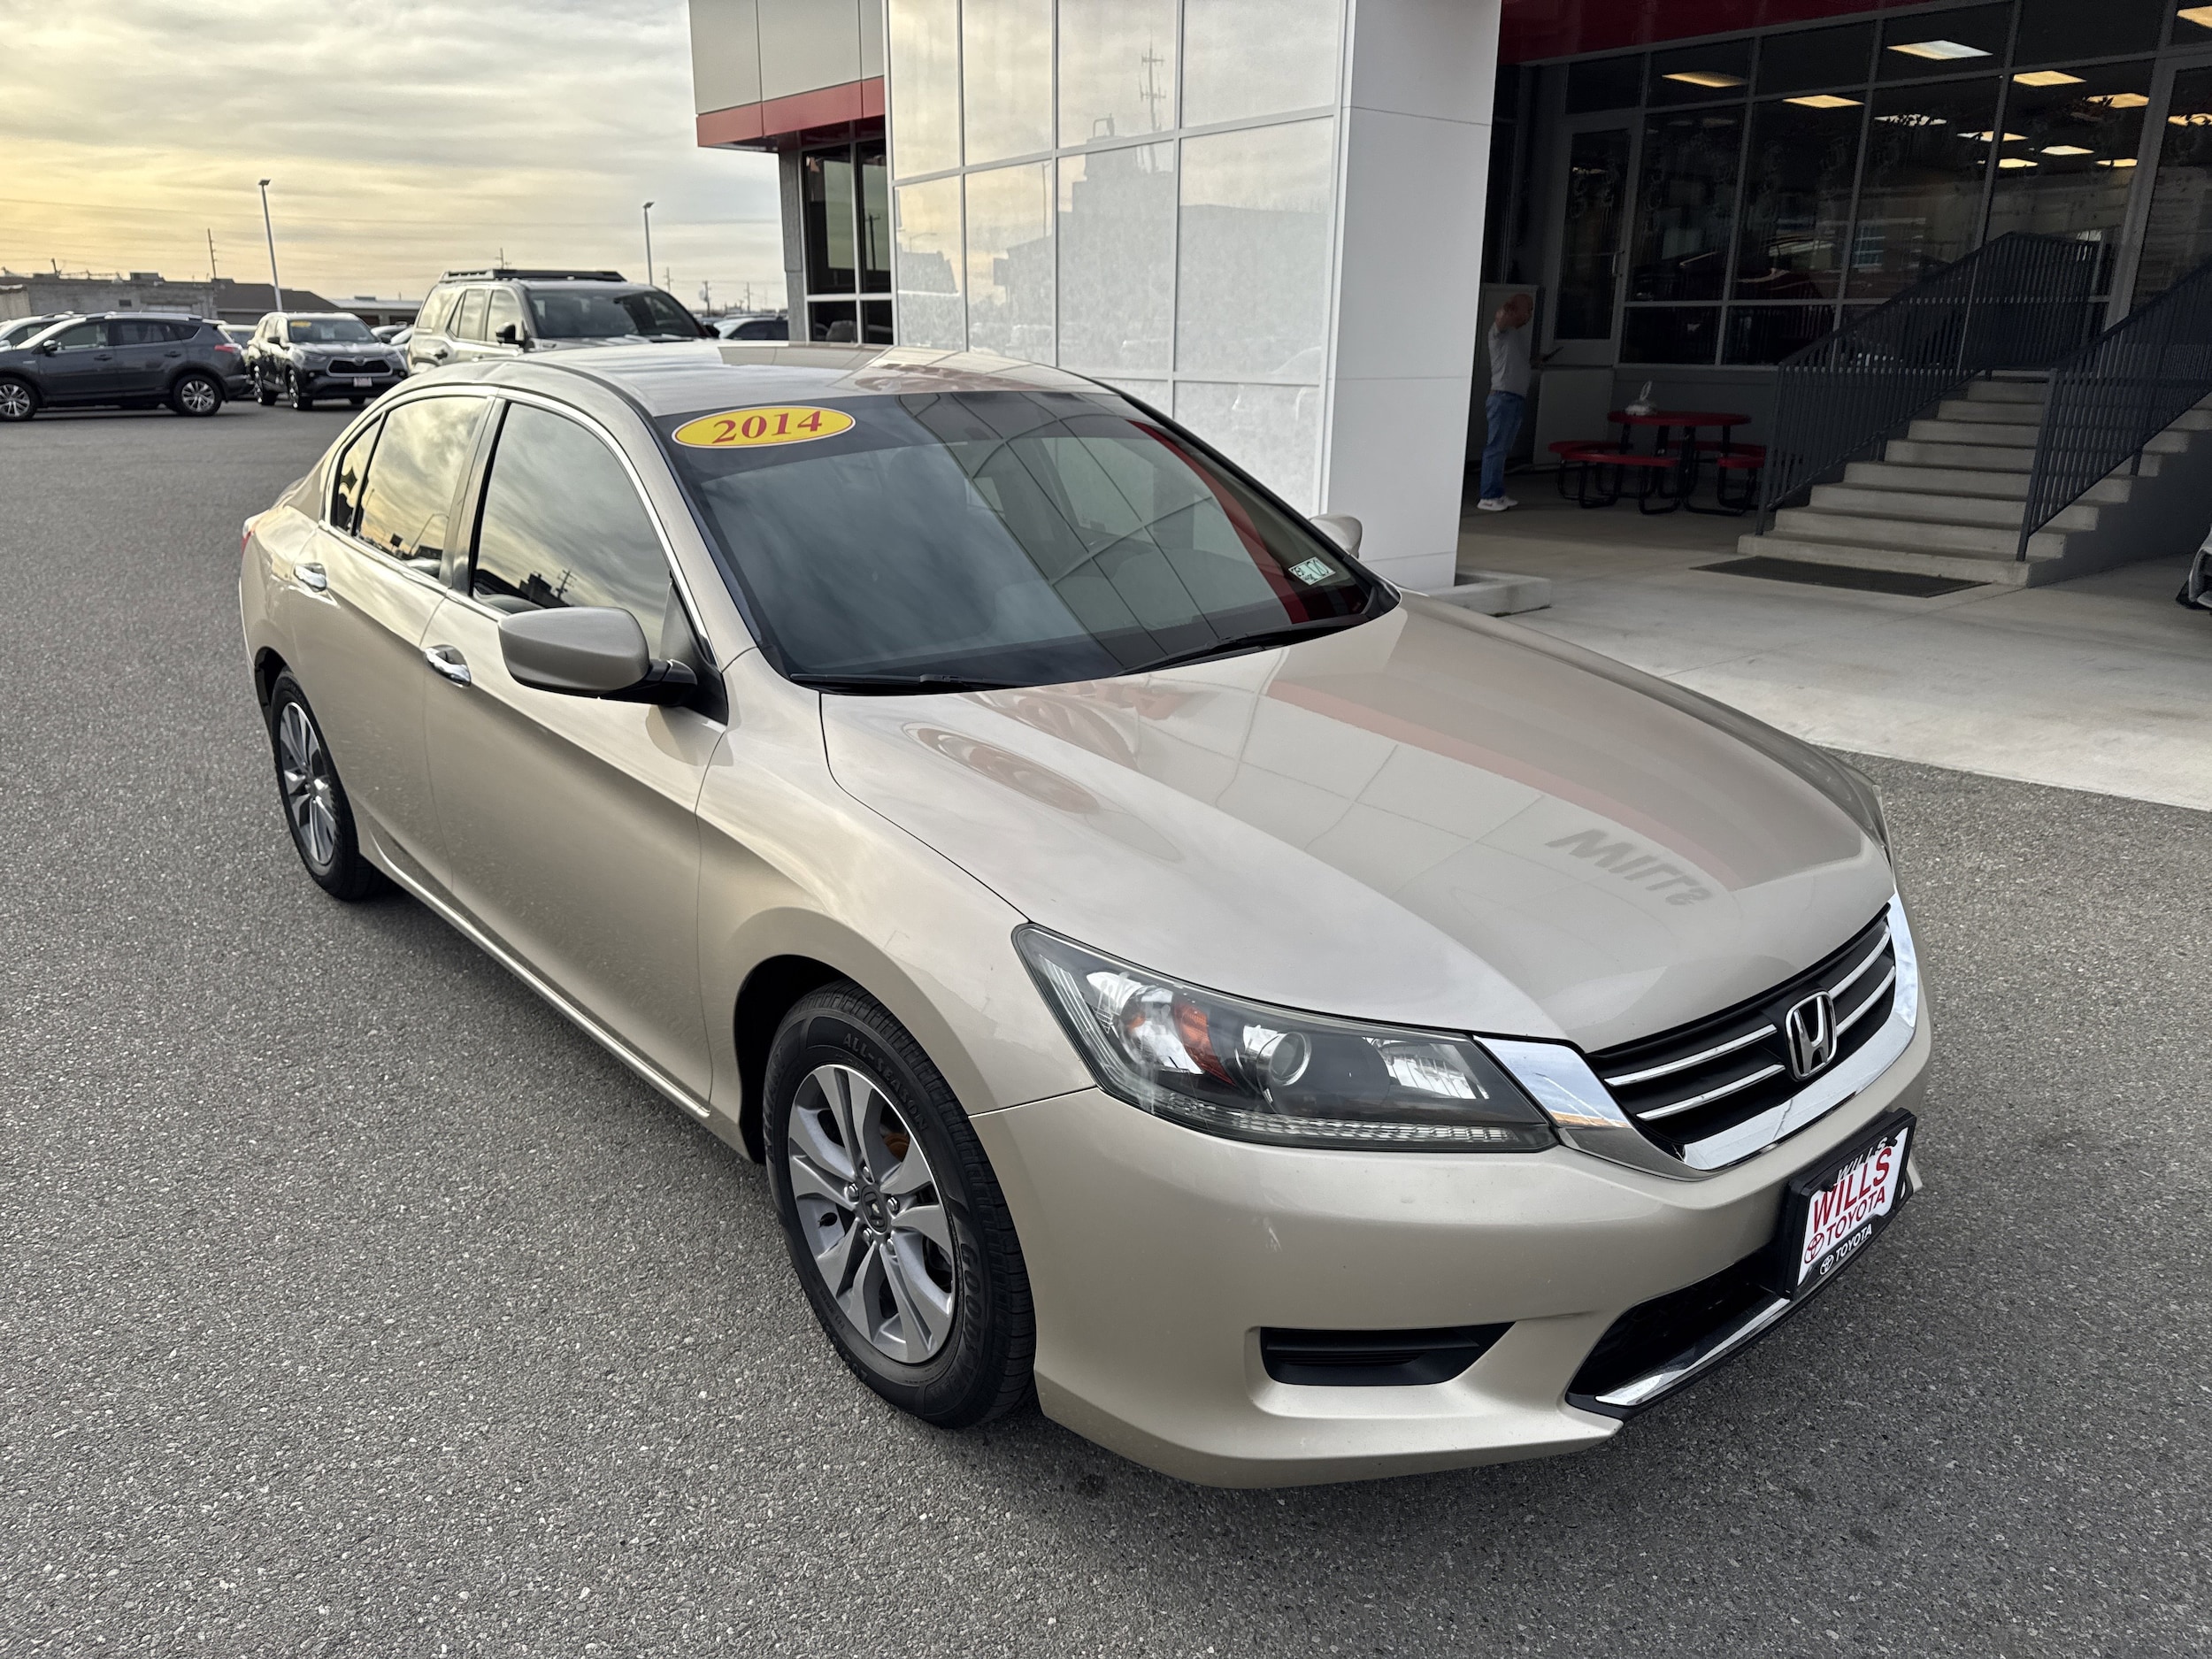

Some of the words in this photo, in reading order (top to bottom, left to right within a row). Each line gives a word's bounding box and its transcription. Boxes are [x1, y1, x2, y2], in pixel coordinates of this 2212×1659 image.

[712, 410, 823, 444] 2014
[1836, 1136, 1888, 1184] WILLS
[1814, 1147, 1893, 1233] WILLS
[1826, 1186, 1886, 1246] TOYOTA
[1835, 1223, 1873, 1262] TOYOTA
